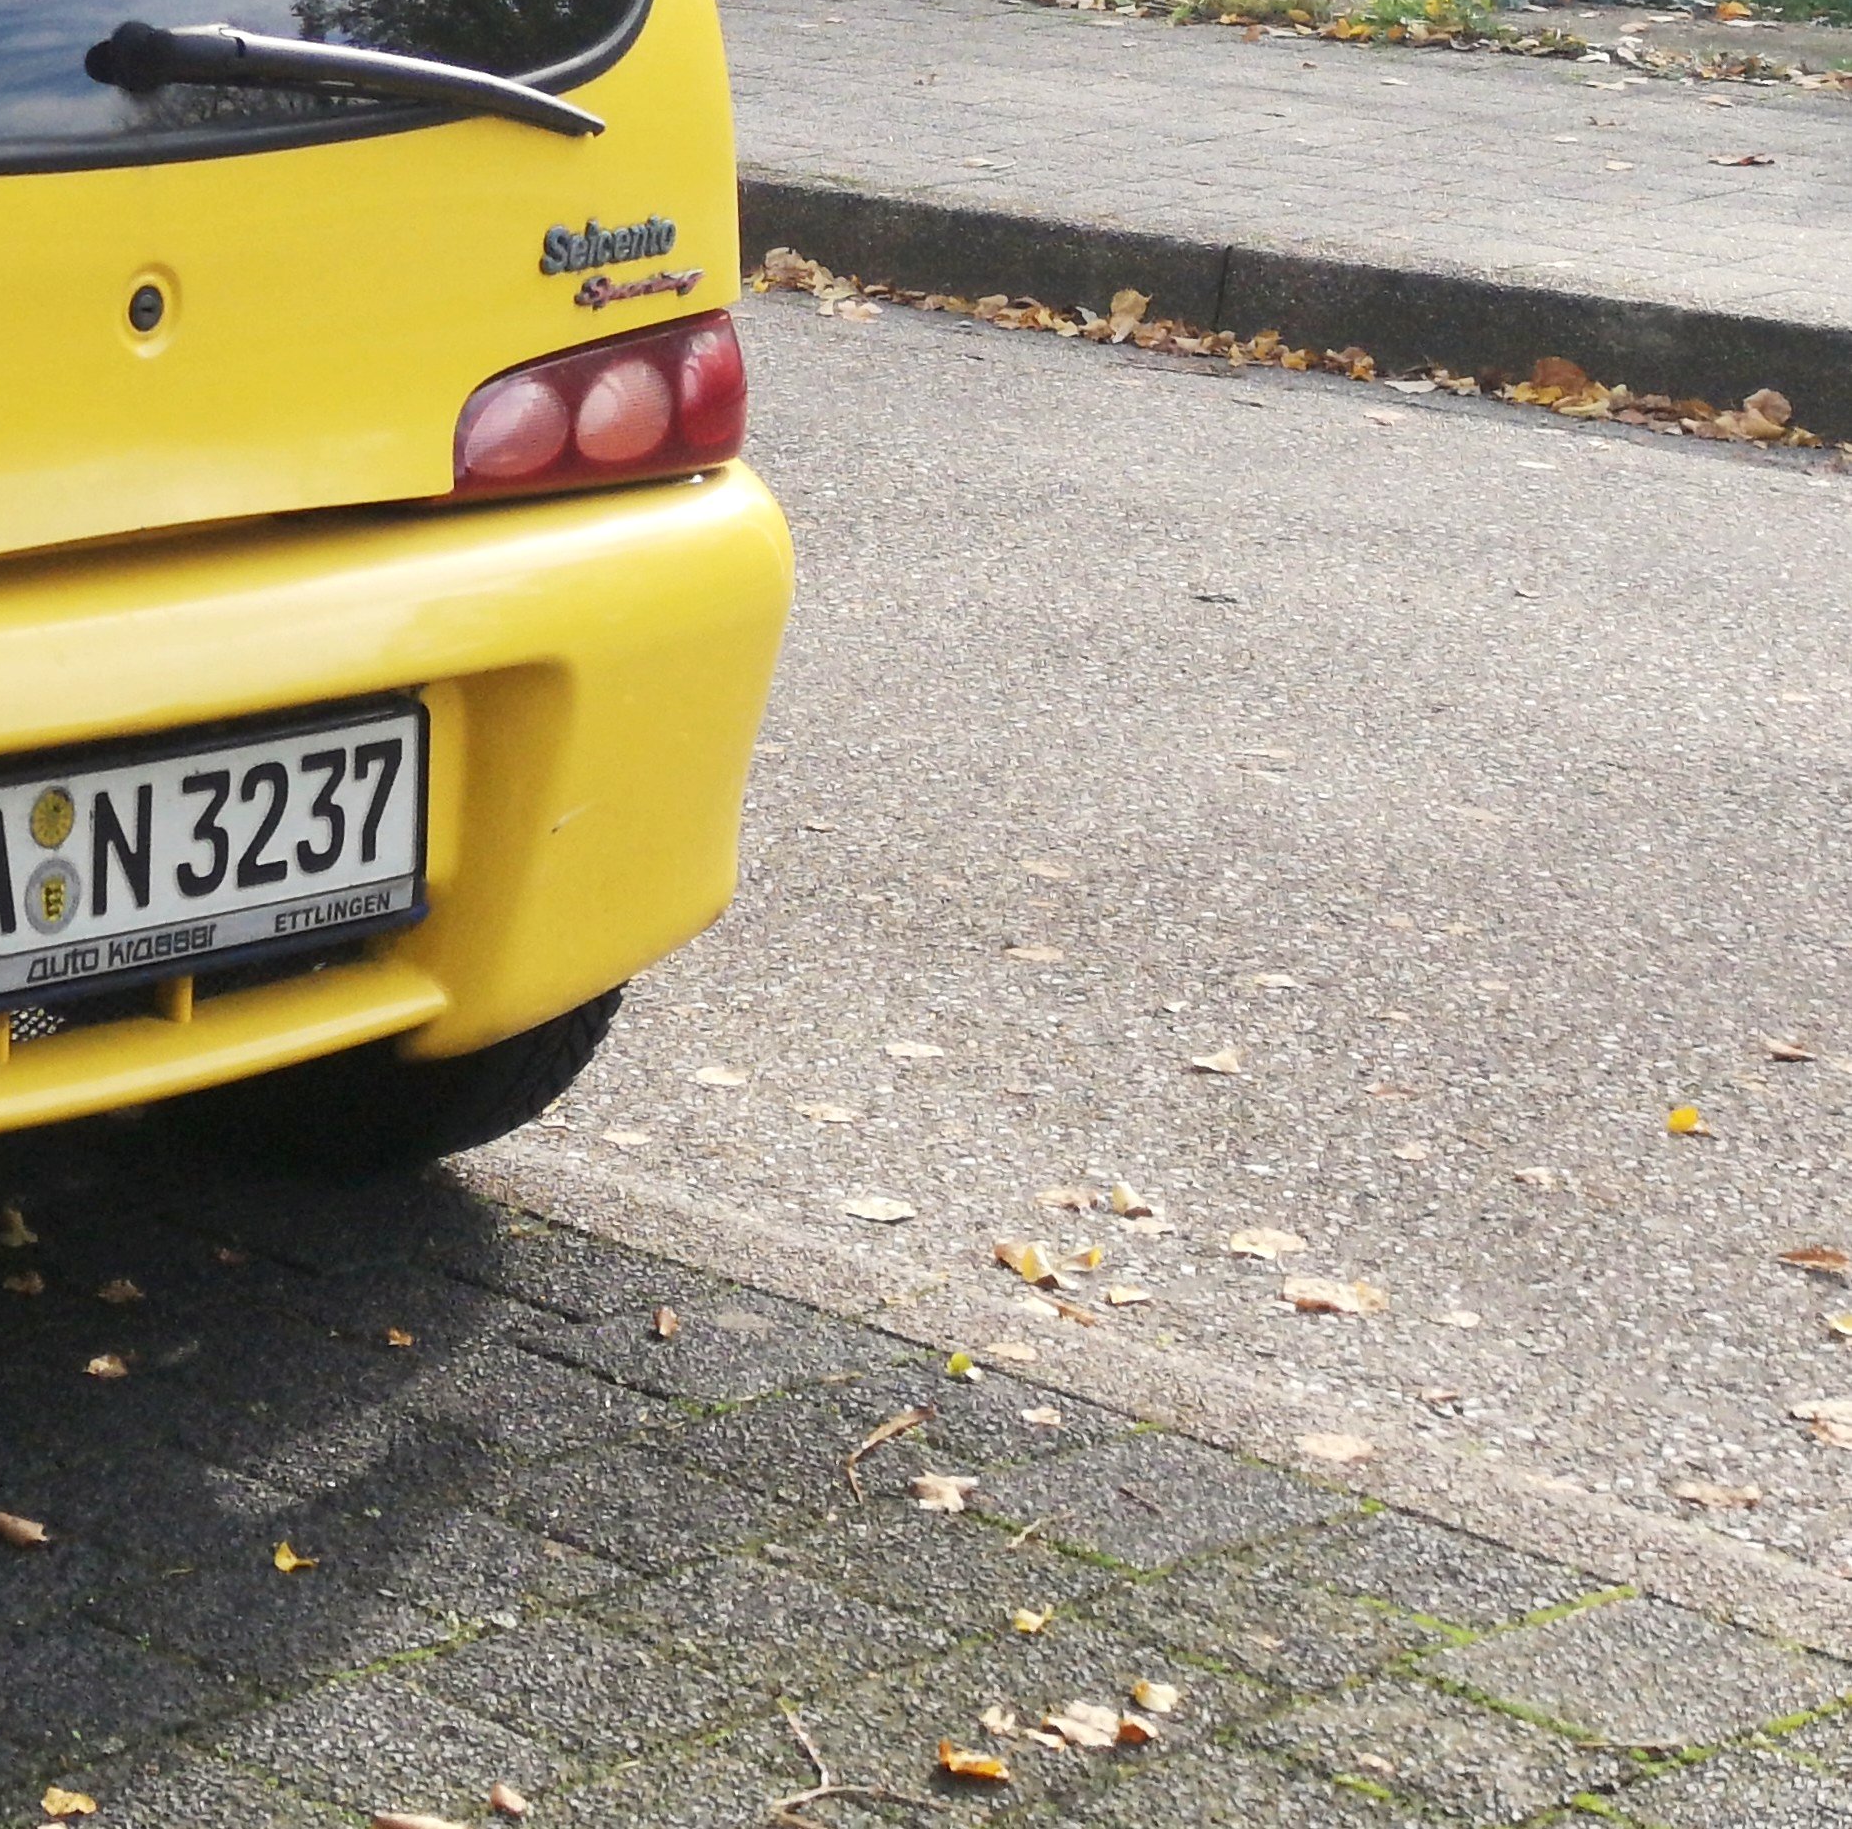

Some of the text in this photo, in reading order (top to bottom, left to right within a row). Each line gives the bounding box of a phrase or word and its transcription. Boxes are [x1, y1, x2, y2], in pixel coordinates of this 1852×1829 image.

[540, 213, 676, 275] Seicento
[91, 782, 153, 916] N
[176, 738, 403, 897] 3237
[26, 947, 99, 984] auto
[274, 891, 391, 933] ETTLINGEN
